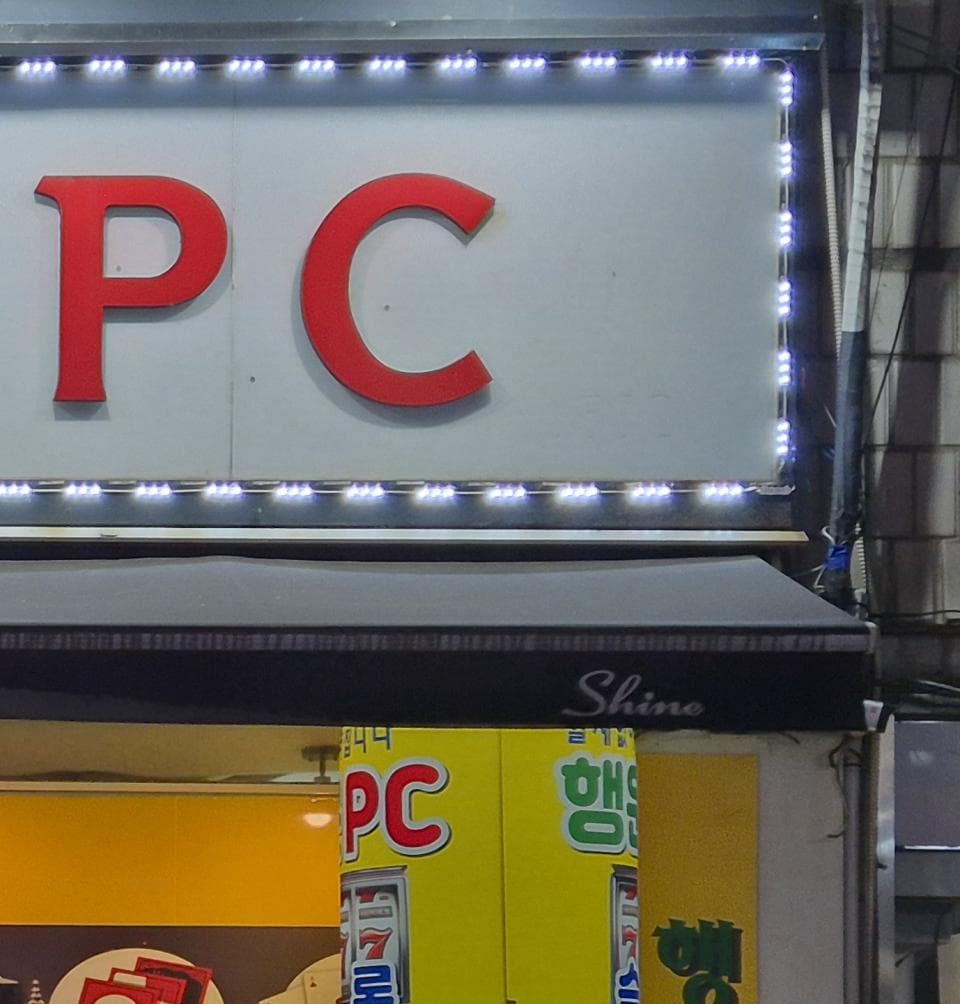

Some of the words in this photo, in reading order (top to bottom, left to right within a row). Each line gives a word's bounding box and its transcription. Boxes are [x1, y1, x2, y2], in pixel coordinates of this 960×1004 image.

[34, 173, 495, 406] PC
[561, 669, 704, 717] Shine
[344, 761, 445, 857] PC
